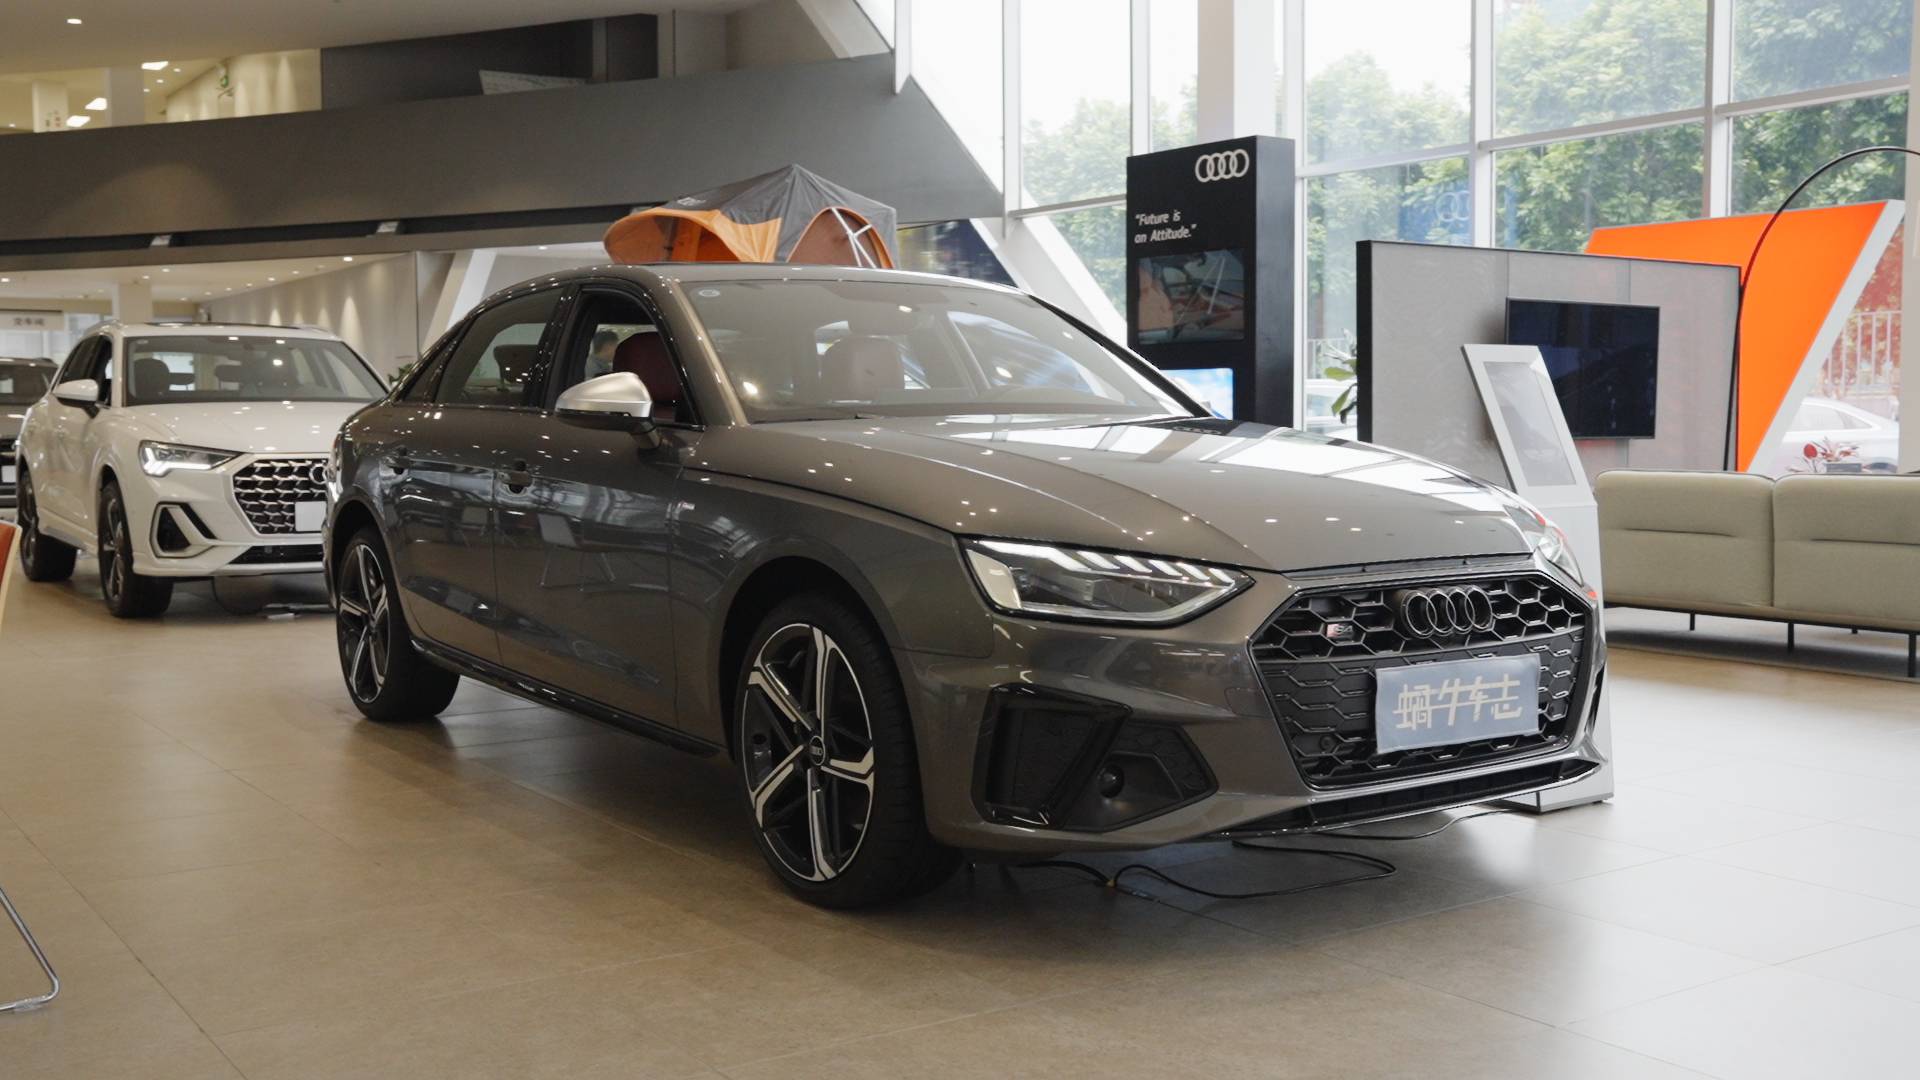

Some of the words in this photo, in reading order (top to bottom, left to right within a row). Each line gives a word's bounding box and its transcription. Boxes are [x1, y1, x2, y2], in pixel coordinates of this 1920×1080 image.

[1172, 209, 1181, 222] is
[1134, 233, 1148, 244] an
[1392, 673, 1523, 731] 蜗牛车志
